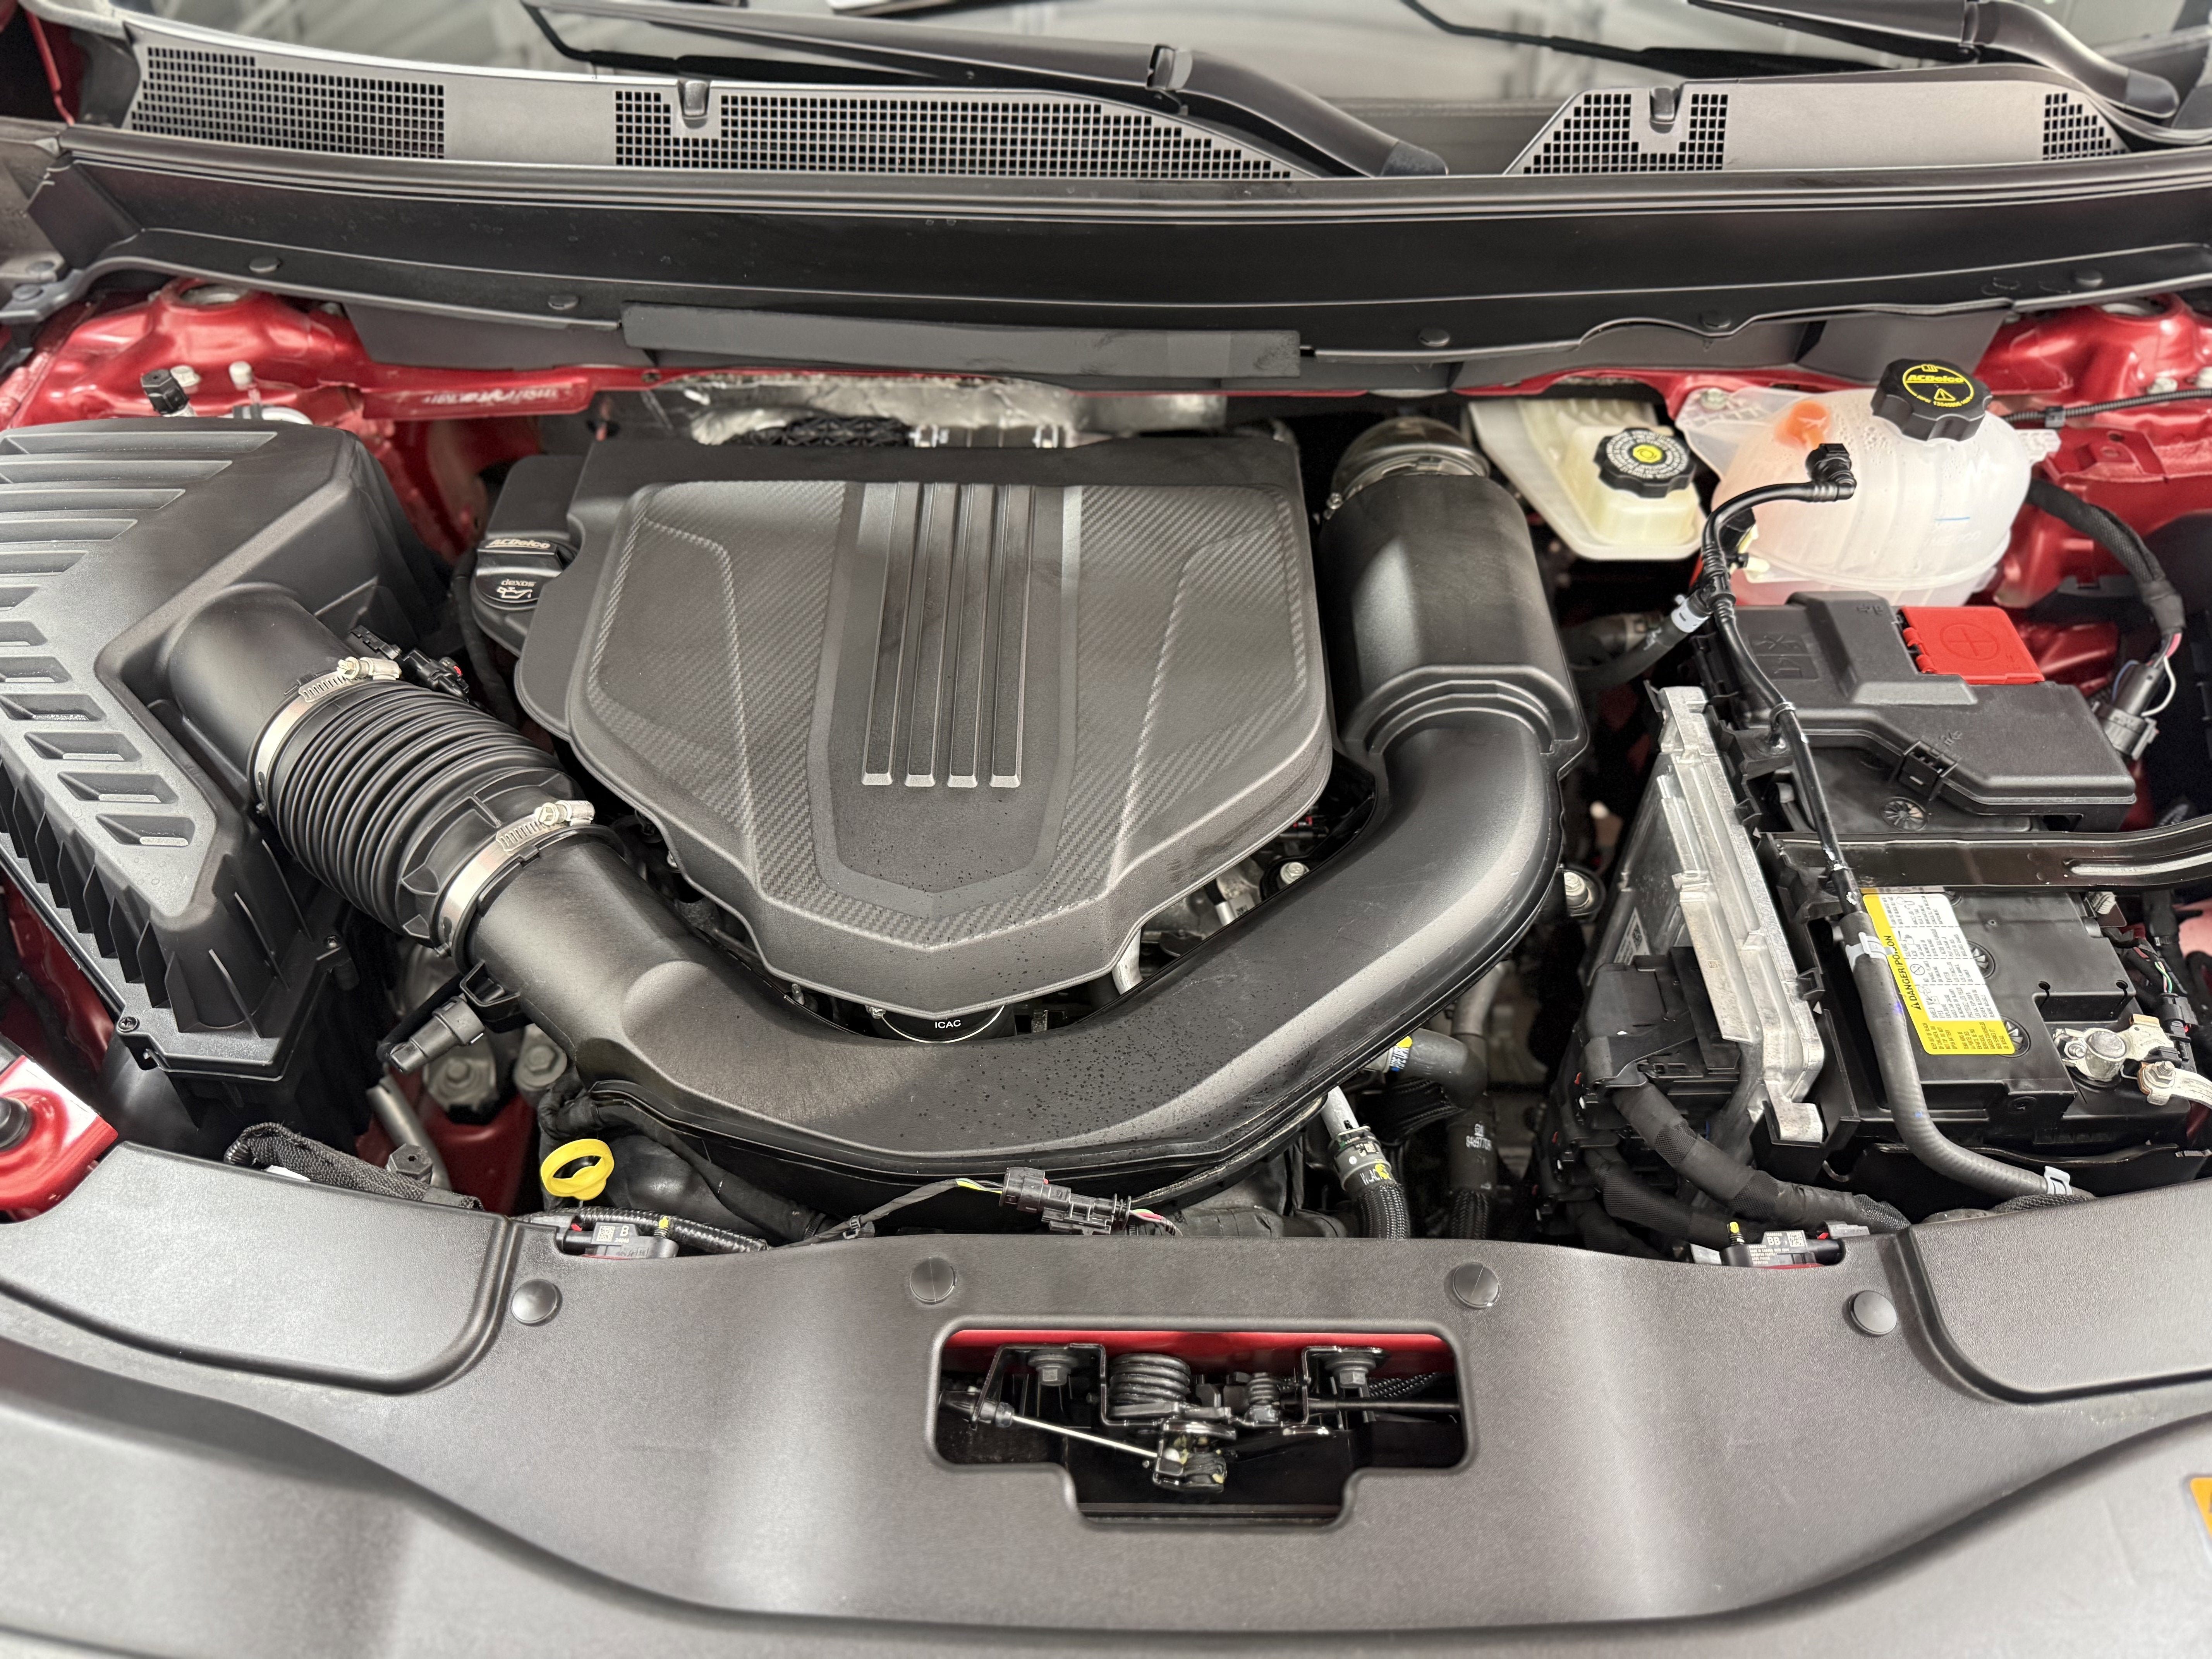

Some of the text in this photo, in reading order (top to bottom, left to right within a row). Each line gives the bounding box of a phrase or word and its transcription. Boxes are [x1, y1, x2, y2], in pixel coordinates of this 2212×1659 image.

[1907, 374, 1964, 383] ACDelco
[489, 539, 551, 548] ACDelco
[935, 1020, 961, 1029] ICAC
[620, 1225, 629, 1237] B
[1767, 1237, 1781, 1245] BB
